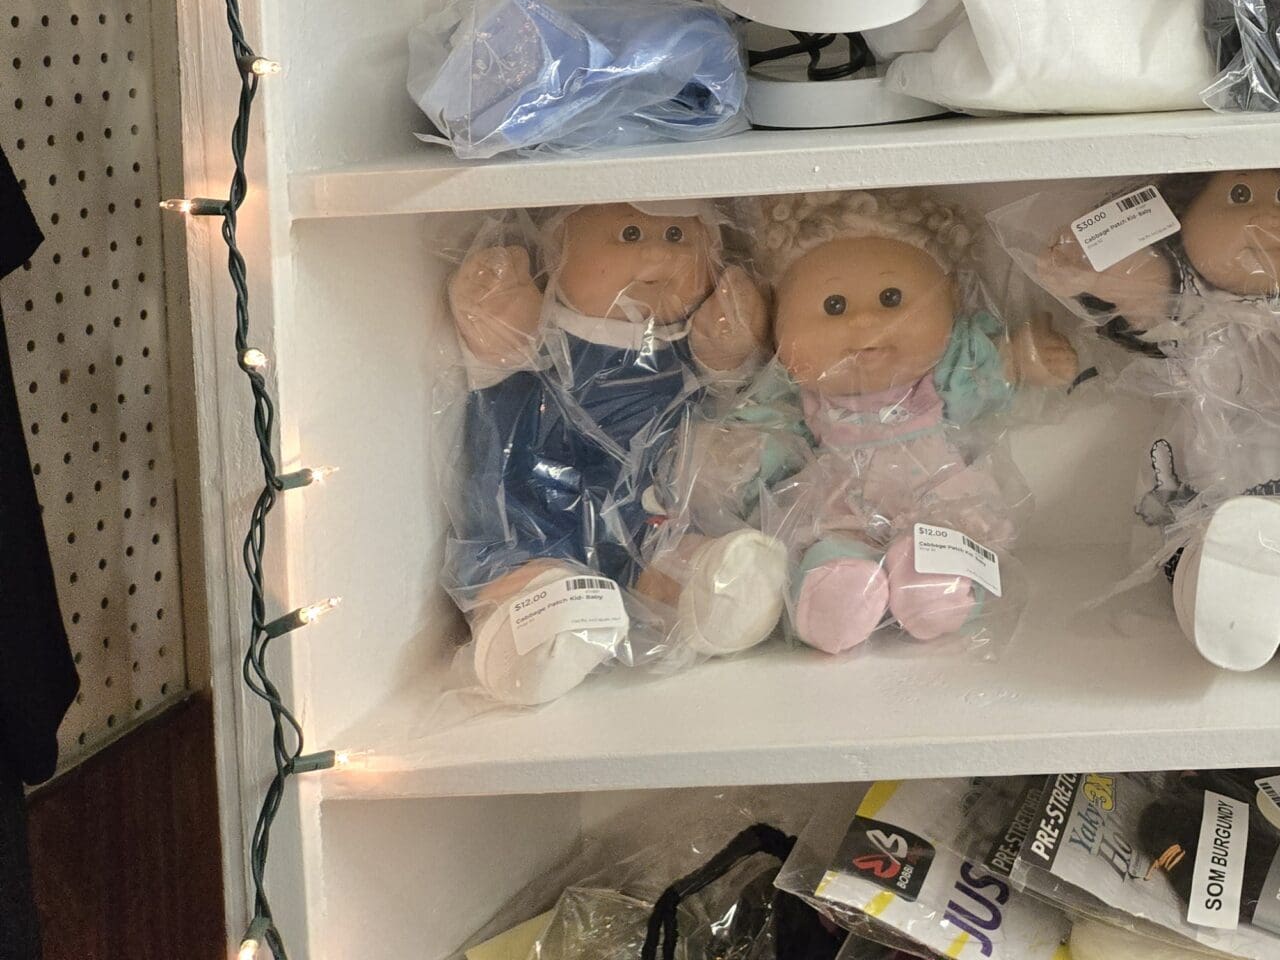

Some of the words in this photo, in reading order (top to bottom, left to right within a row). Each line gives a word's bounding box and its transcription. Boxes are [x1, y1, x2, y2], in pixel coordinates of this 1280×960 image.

[1076, 211, 1107, 232] $30.00
[1084, 228, 1110, 245] Cabbage
[1110, 219, 1128, 230] Patch
[919, 526, 948, 538] $12.00
[515, 591, 547, 612] $12.00
[1031, 773, 1079, 861] PRE-STRETC
[1069, 804, 1106, 854] Yaky
[1211, 799, 1234, 868] BURGUNDY
[897, 864, 914, 890] BOBBI
[1205, 869, 1227, 911] SOM
[943, 861, 1010, 958] JUS
